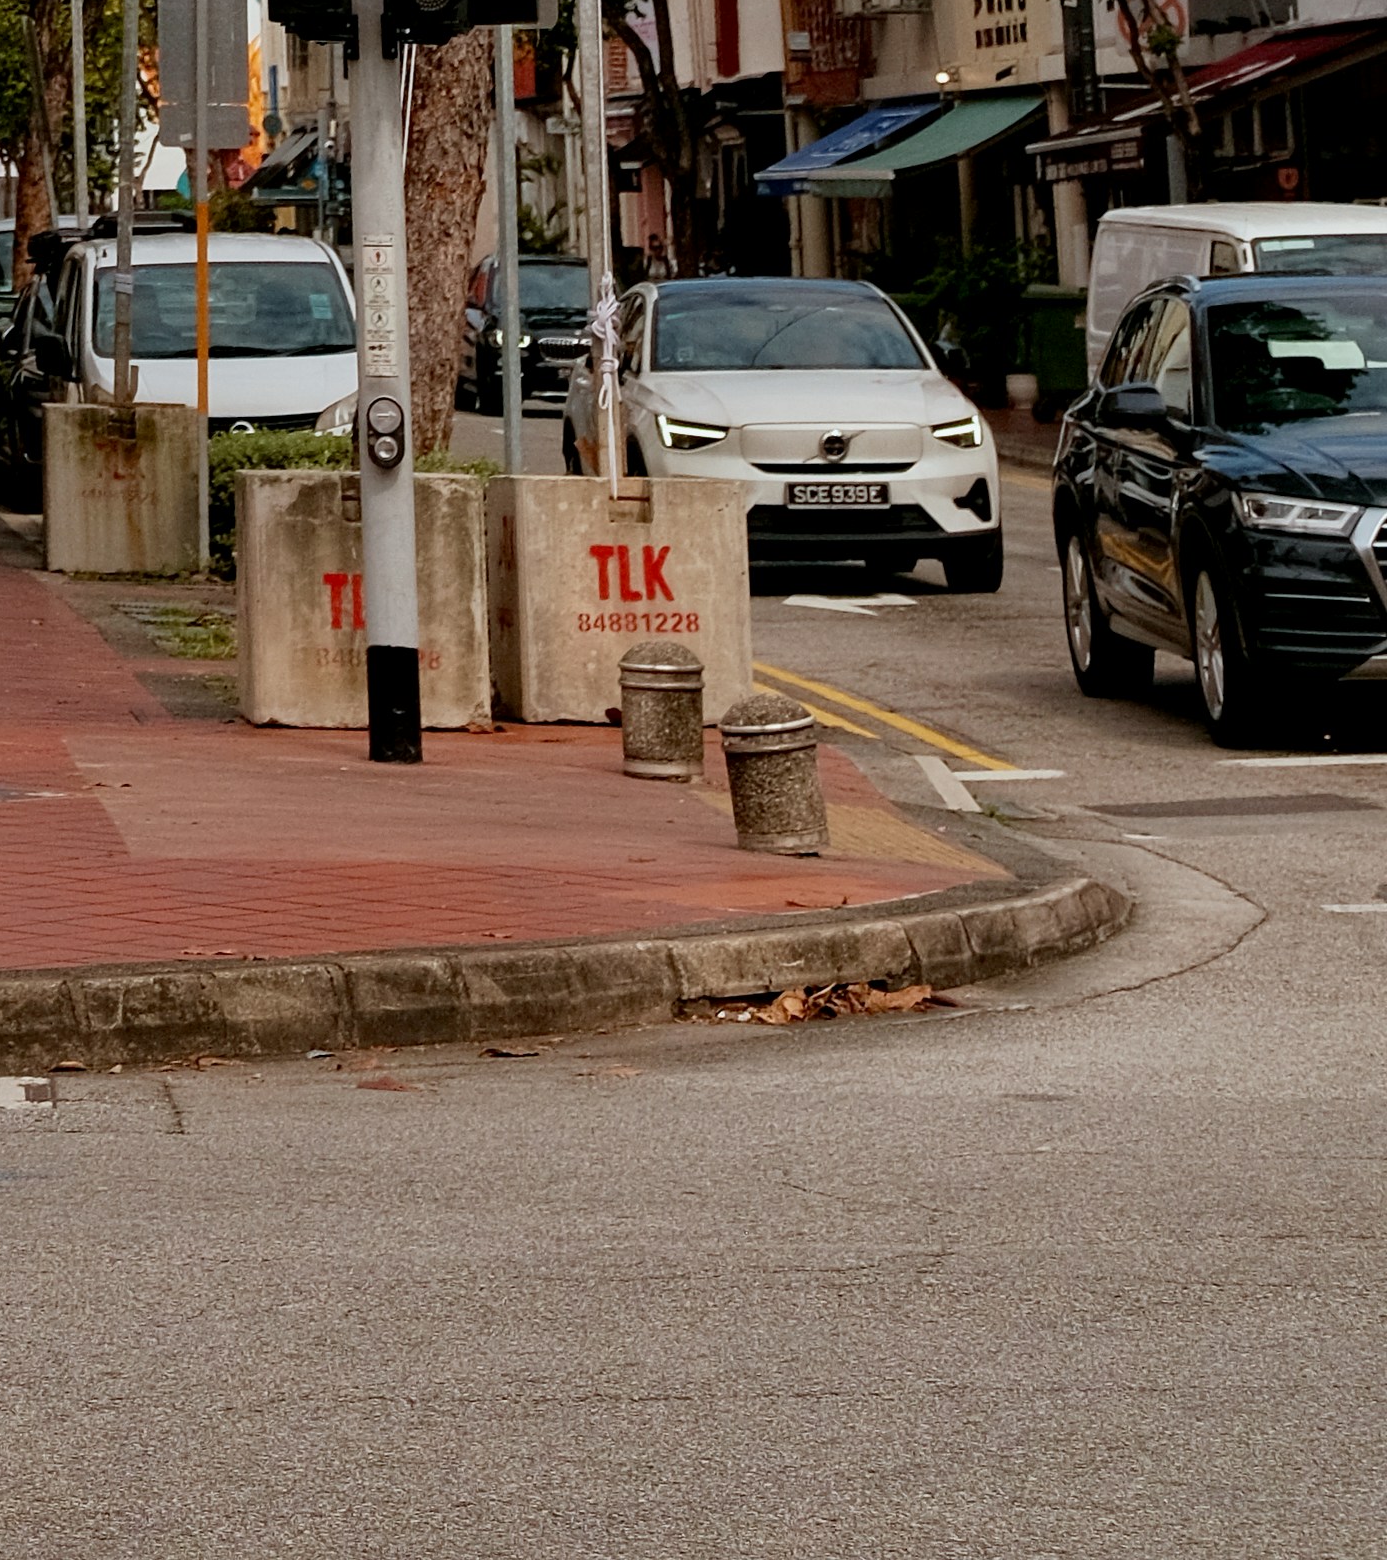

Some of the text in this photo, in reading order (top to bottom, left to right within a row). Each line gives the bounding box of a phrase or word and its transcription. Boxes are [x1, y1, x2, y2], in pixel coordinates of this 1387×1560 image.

[322, 571, 367, 631] TL
[588, 544, 676, 603] TLK
[577, 612, 701, 634] 84881228
